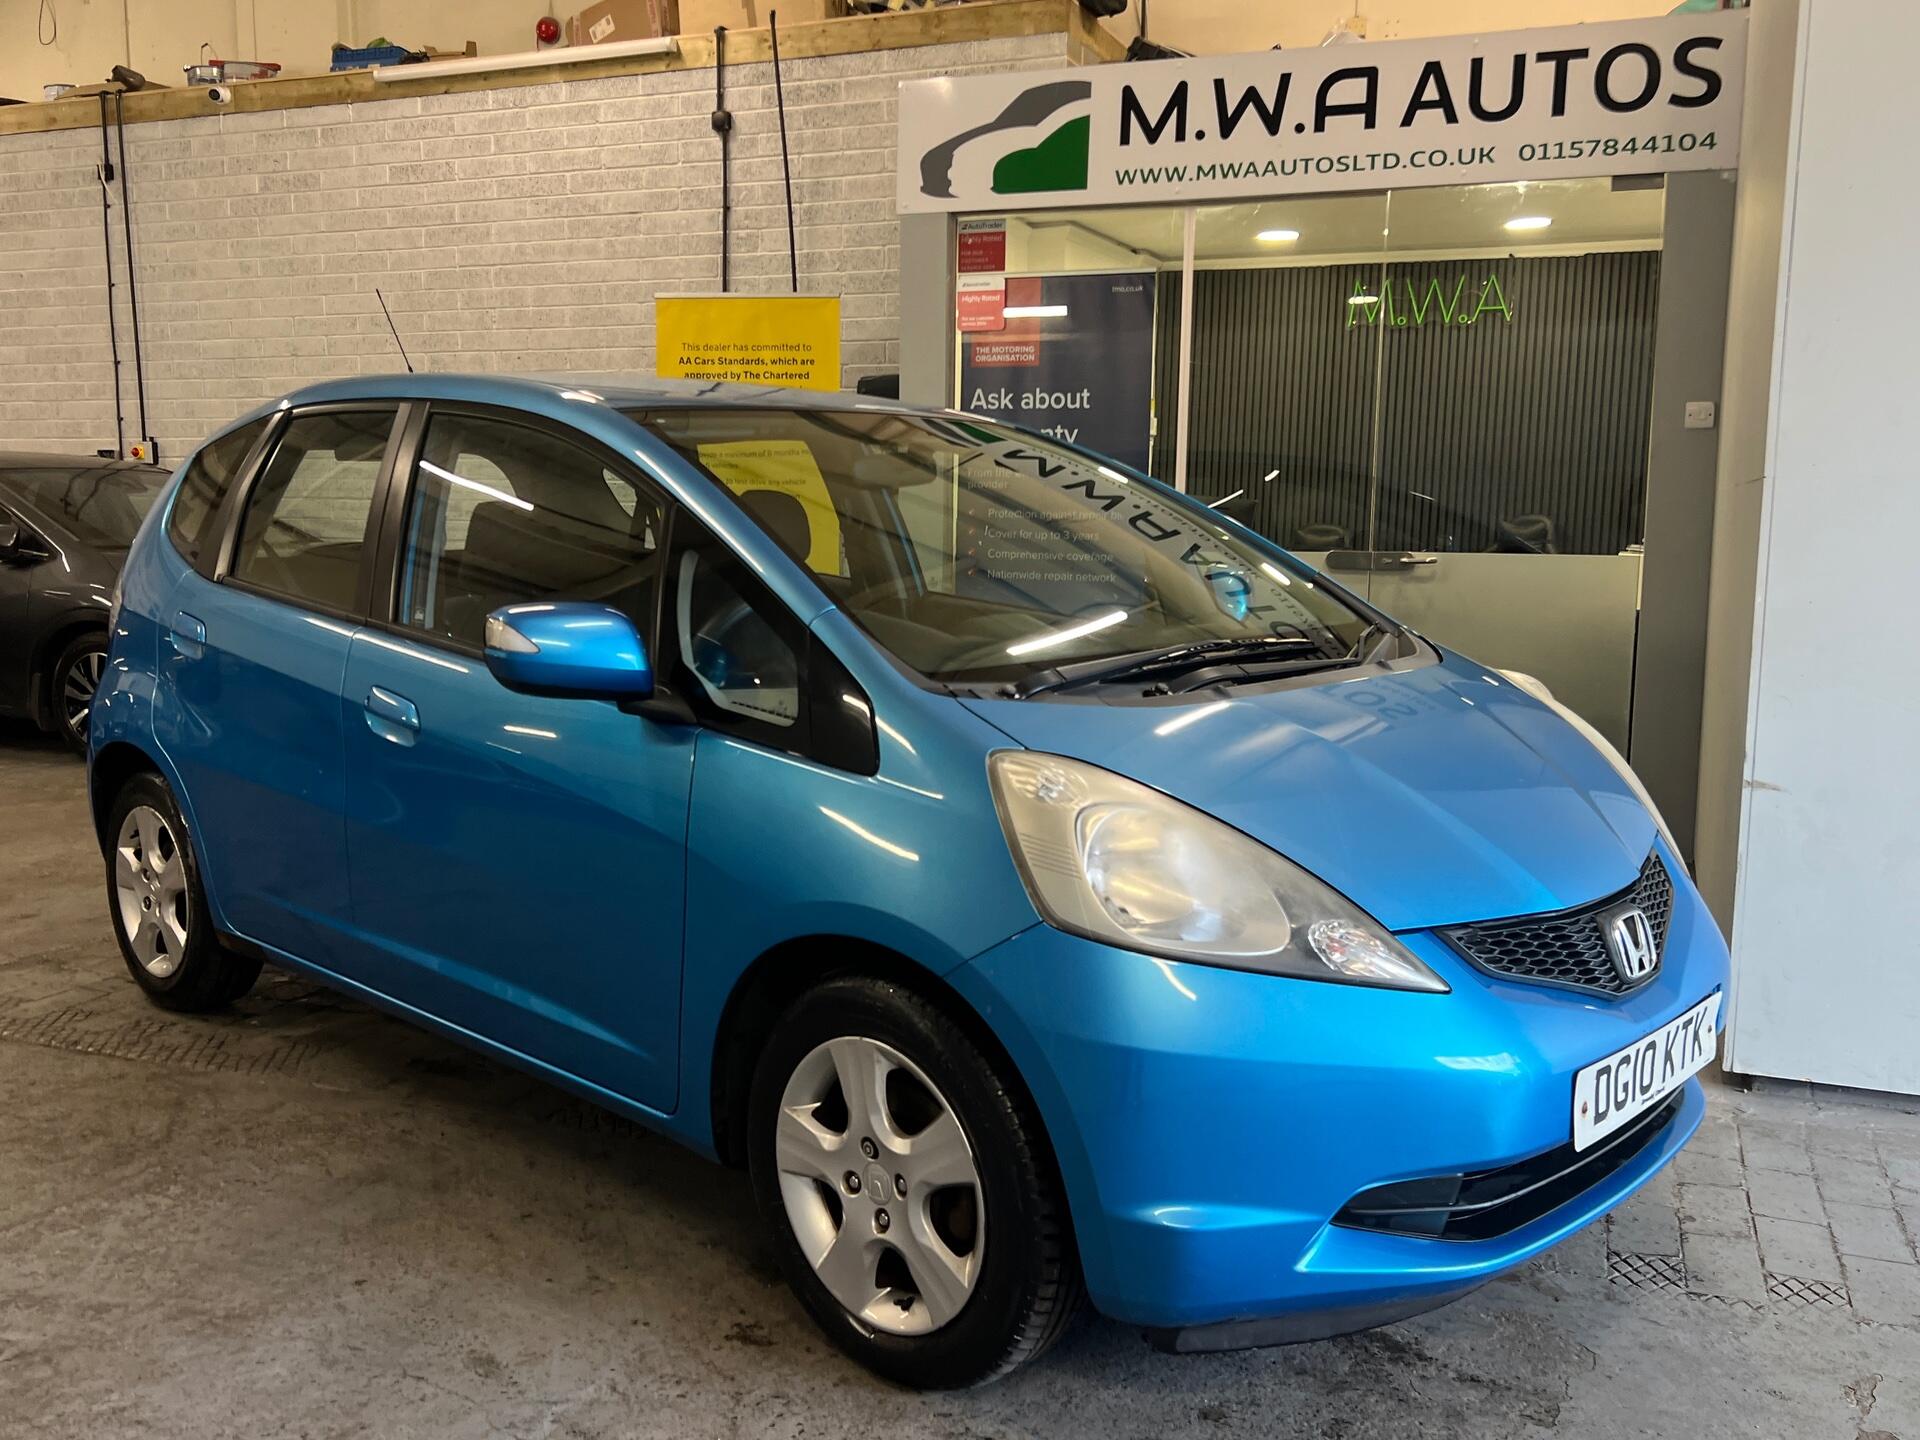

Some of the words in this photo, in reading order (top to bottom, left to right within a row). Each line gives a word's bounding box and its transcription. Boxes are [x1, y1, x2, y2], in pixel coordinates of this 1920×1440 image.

[1119, 66, 1379, 146] M.W.A
[1399, 36, 1724, 128] AUTOS
[1115, 146, 1496, 186] WWW.MWAAUTOSLTD.CO.UK
[1518, 131, 1718, 162] 01157844104
[1348, 273, 1512, 328] M.W.A
[682, 343, 701, 352] This
[703, 343, 731, 352] dealer
[733, 343, 749, 352] has
[751, 343, 800, 352] committed
[802, 343, 812, 352] to
[976, 346, 990, 354] THE
[991, 345, 1035, 354] MOTORING
[678, 357, 692, 365] AA
[694, 357, 716, 366] Cars
[717, 357, 769, 367] Standards,
[770, 357, 798, 366] which
[975, 354, 1035, 363] ORGANISATION
[684, 371, 728, 380] approved
[730, 371, 741, 381] by
[743, 371, 761, 380] The
[763, 371, 810, 380] Chartered
[970, 388, 1014, 410] Ask
[1021, 387, 1091, 410] about
[987, 509, 1037, 519] Protection
[988, 529, 1017, 539] Cover
[1019, 529, 1033, 539] for
[1034, 532, 1048, 542] up
[1050, 530, 1061, 539] to
[1063, 530, 1070, 539] 3
[1072, 531, 1099, 543] years
[987, 548, 1064, 563] Comprehensive
[1066, 551, 1113, 564] coverage
[987, 569, 1042, 581] Nationwide
[1044, 570, 1074, 583] repair
[1075, 571, 1117, 584] network
[1593, 1040, 1658, 1127] DG10
[1662, 1006, 1708, 1084] KTK
